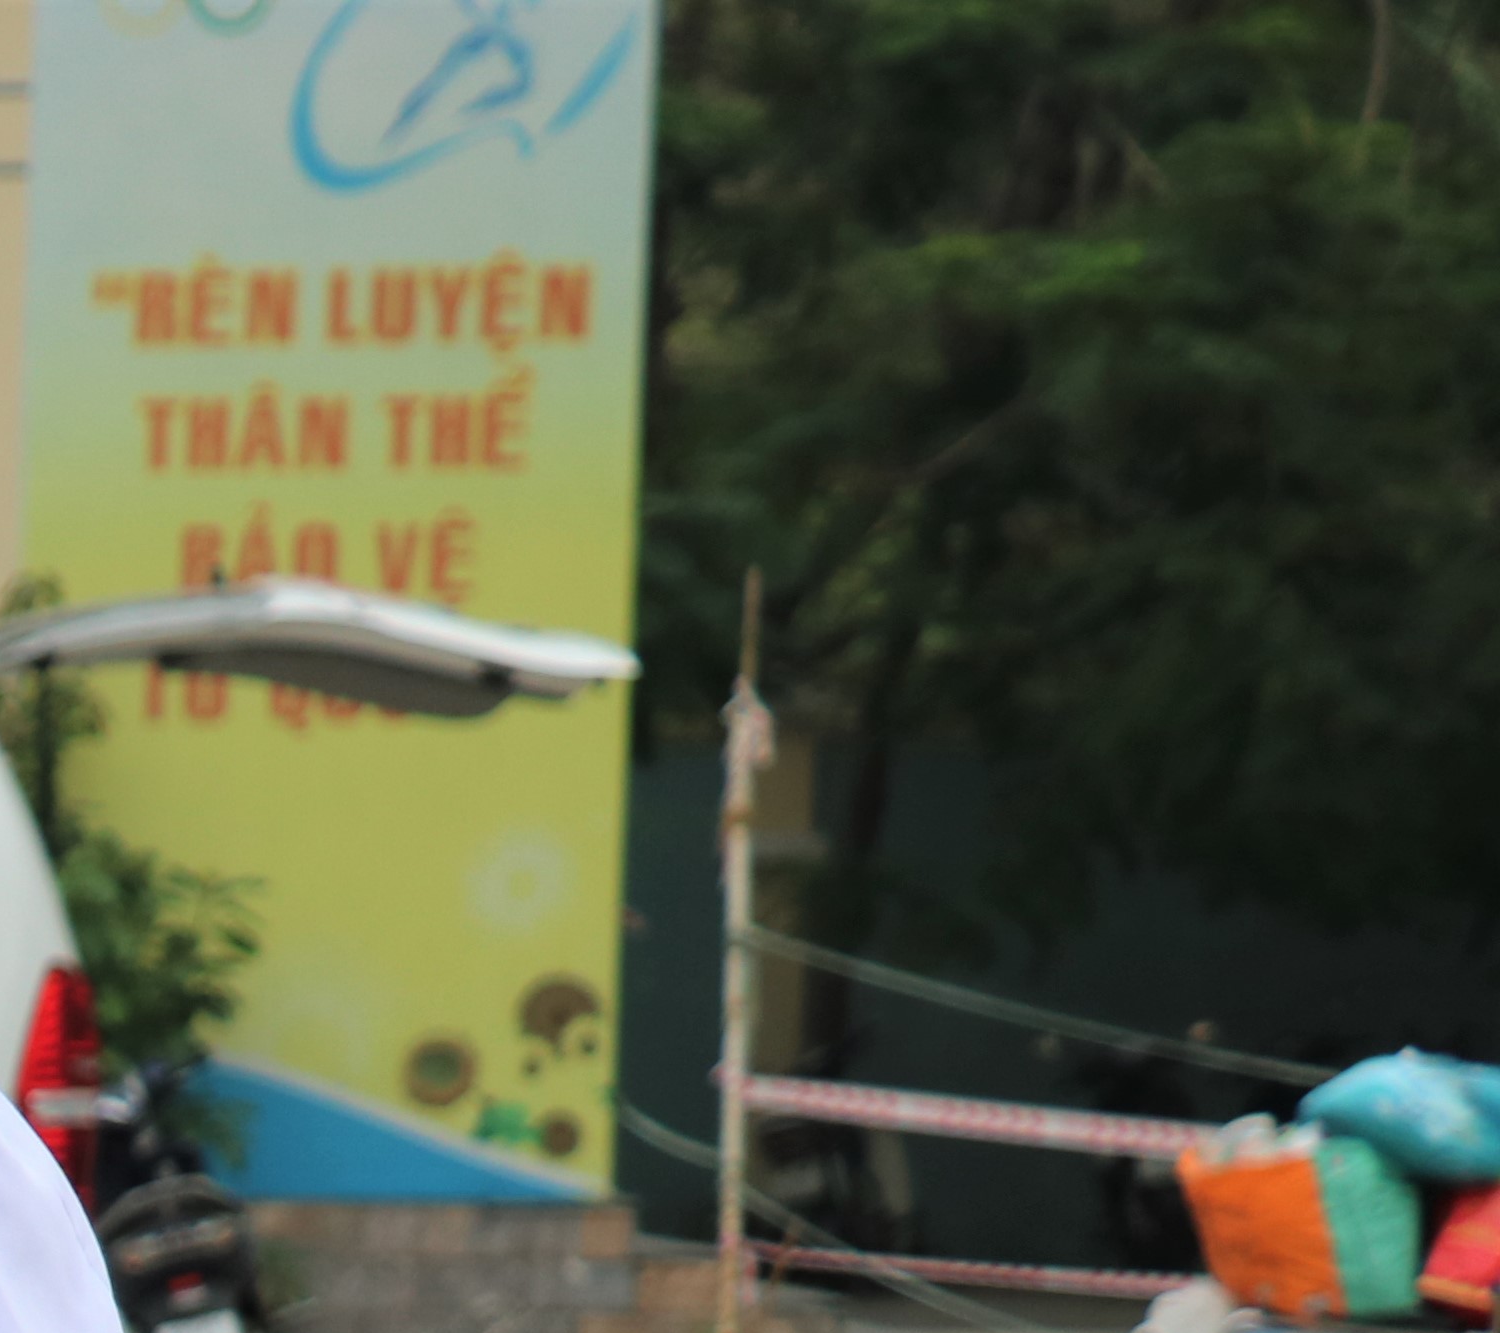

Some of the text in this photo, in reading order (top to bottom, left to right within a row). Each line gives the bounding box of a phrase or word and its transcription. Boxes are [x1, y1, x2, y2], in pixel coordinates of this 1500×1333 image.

[325, 246, 591, 360] LUYỆN
[138, 362, 537, 474] THÂN THỂ
